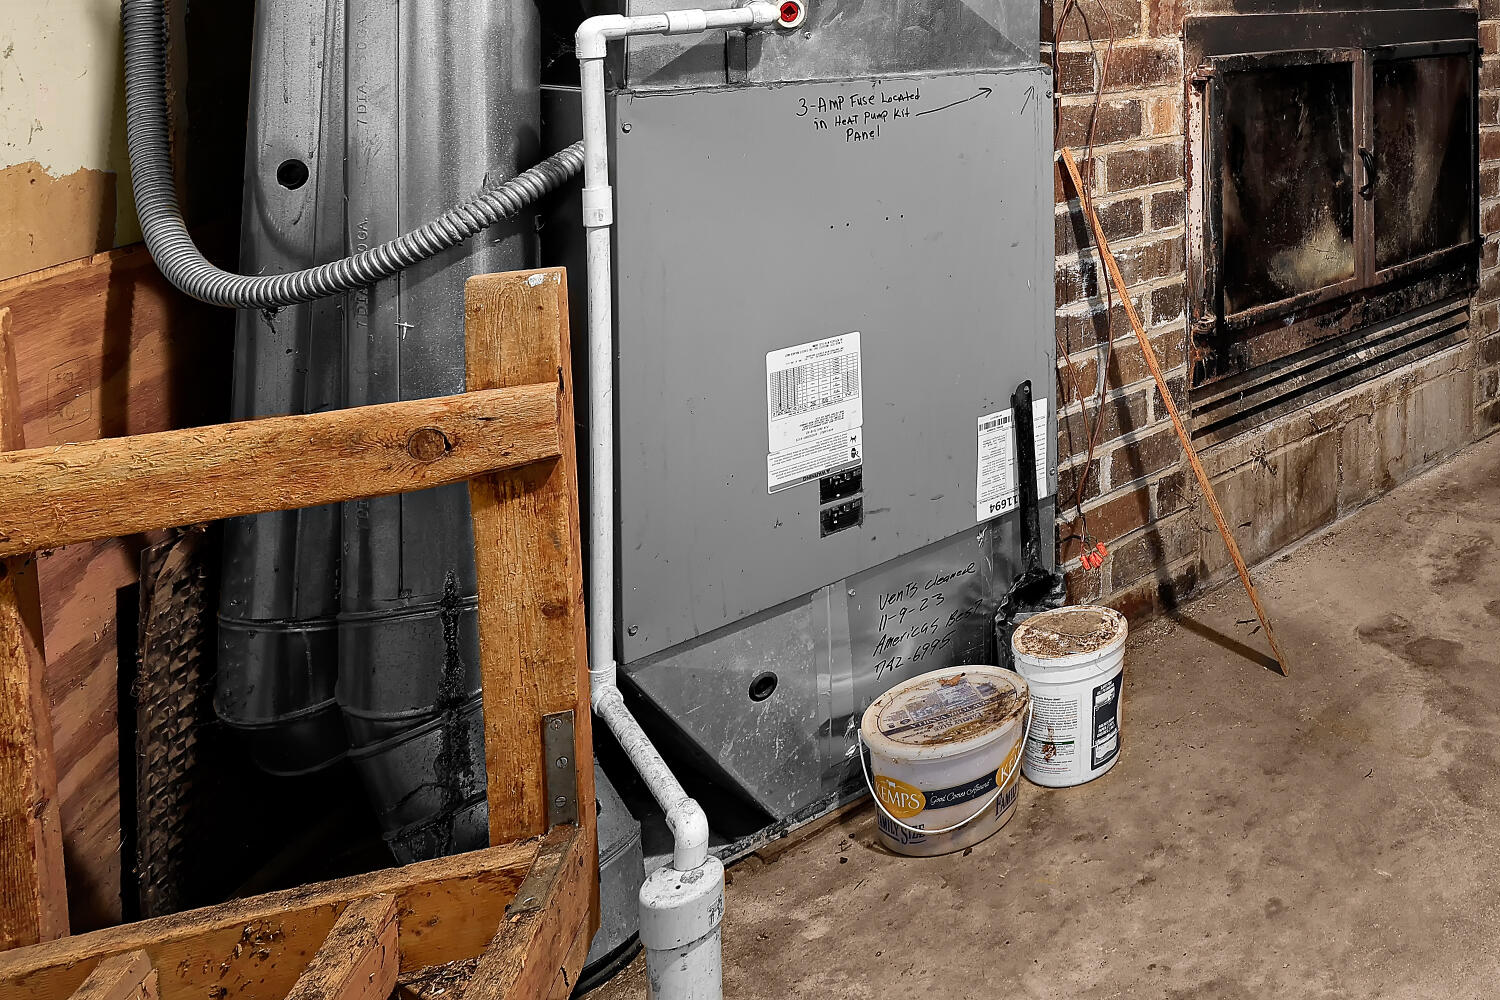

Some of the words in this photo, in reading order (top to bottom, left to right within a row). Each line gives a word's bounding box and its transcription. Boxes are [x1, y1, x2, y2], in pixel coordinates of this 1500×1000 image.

[850, 94, 875, 107] Fuse
[814, 117, 828, 130] in
[893, 107, 911, 120] Kit
[989, 495, 1018, 514] 11694
